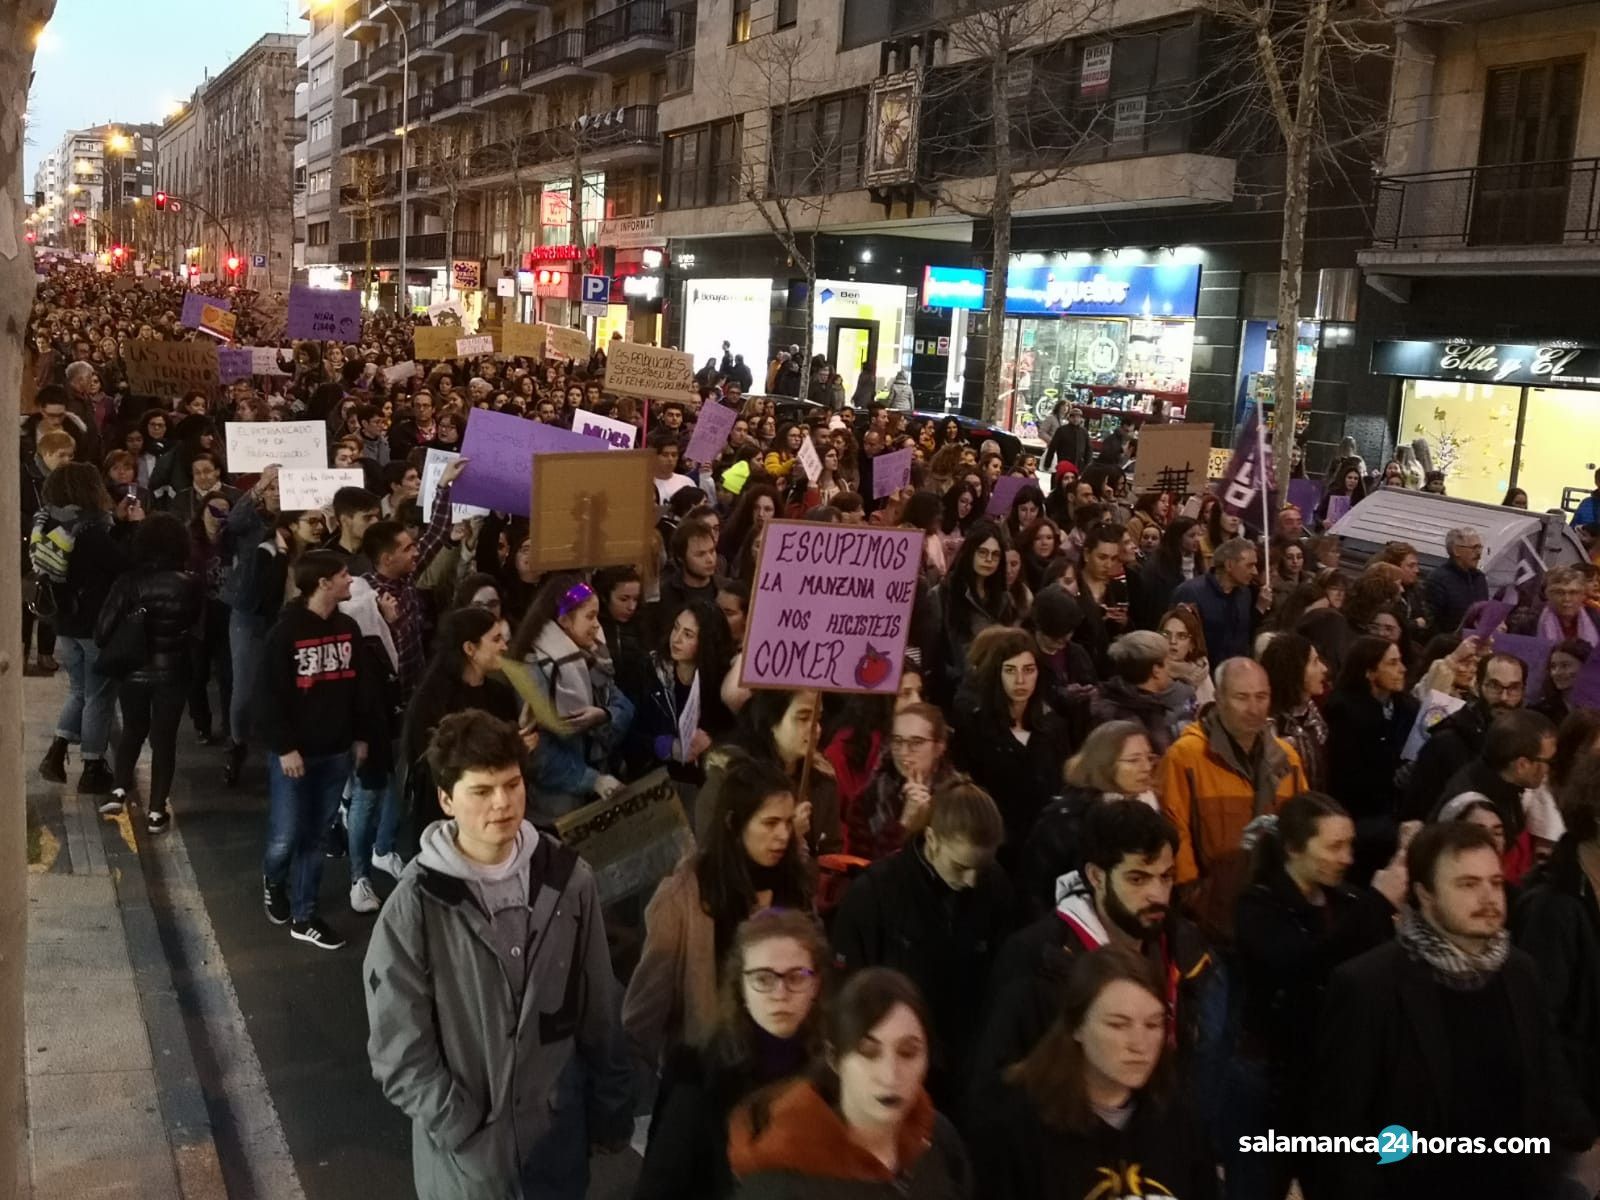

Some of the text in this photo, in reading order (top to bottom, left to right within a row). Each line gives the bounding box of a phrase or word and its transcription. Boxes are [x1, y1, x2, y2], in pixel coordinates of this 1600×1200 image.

[587, 278, 605, 299] P
[1440, 345, 1498, 372] Ella
[1493, 357, 1522, 381] y
[582, 422, 631, 449] MUJER
[776, 531, 909, 570] ESCUPIMOS
[760, 572, 914, 604] LA MANZANA QUE
[777, 609, 902, 639] NOS HICISTEIS
[754, 639, 845, 687] COMER
